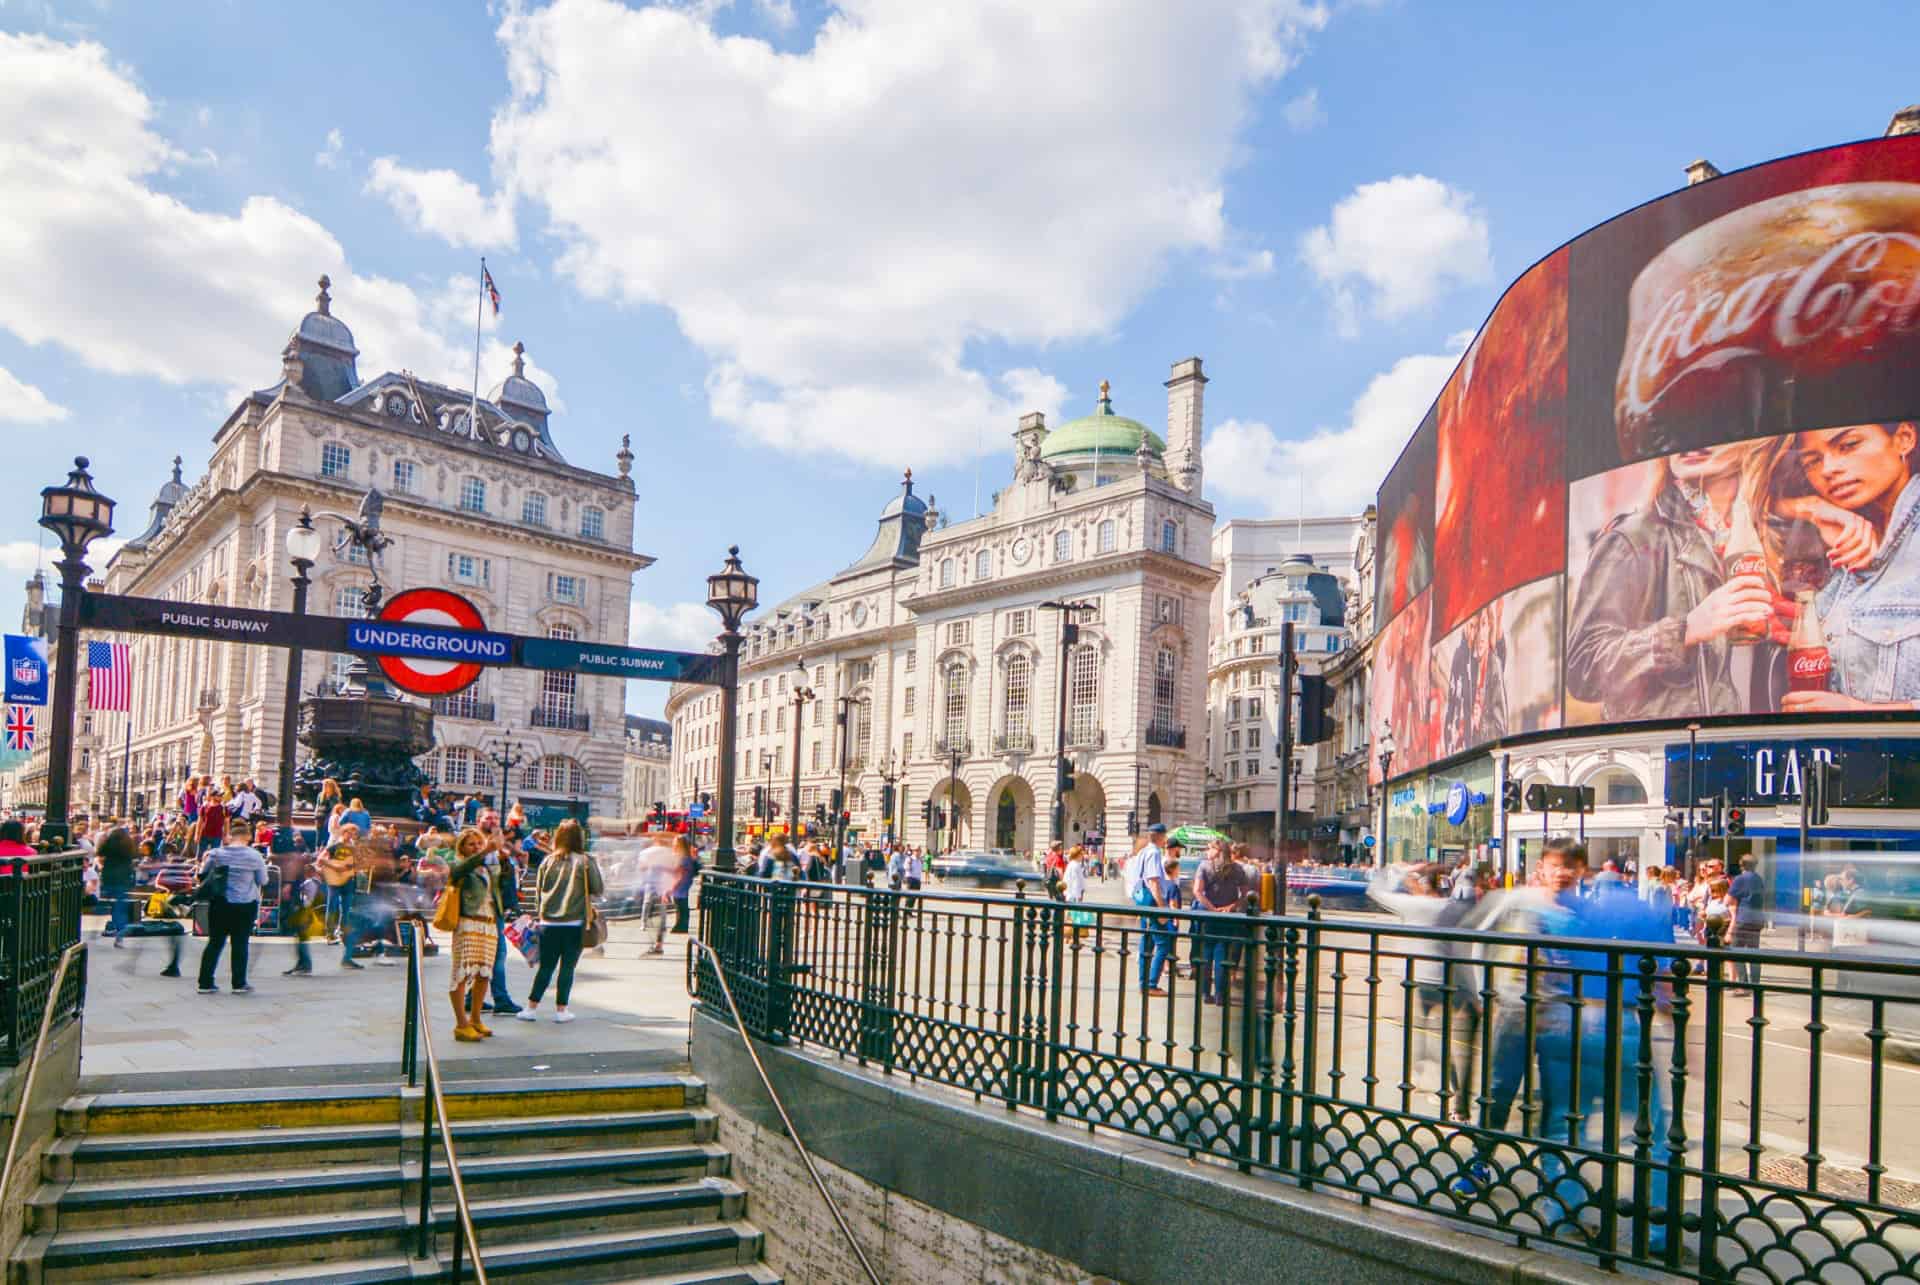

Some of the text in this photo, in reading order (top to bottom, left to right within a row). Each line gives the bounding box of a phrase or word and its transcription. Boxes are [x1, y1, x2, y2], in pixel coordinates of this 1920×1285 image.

[162, 612, 269, 632] PUBLIC SUBWAY
[355, 628, 505, 656] UNDERGROUND
[580, 653, 664, 669] PUBLIC SUBWAY
[1756, 748, 1832, 796] GA
